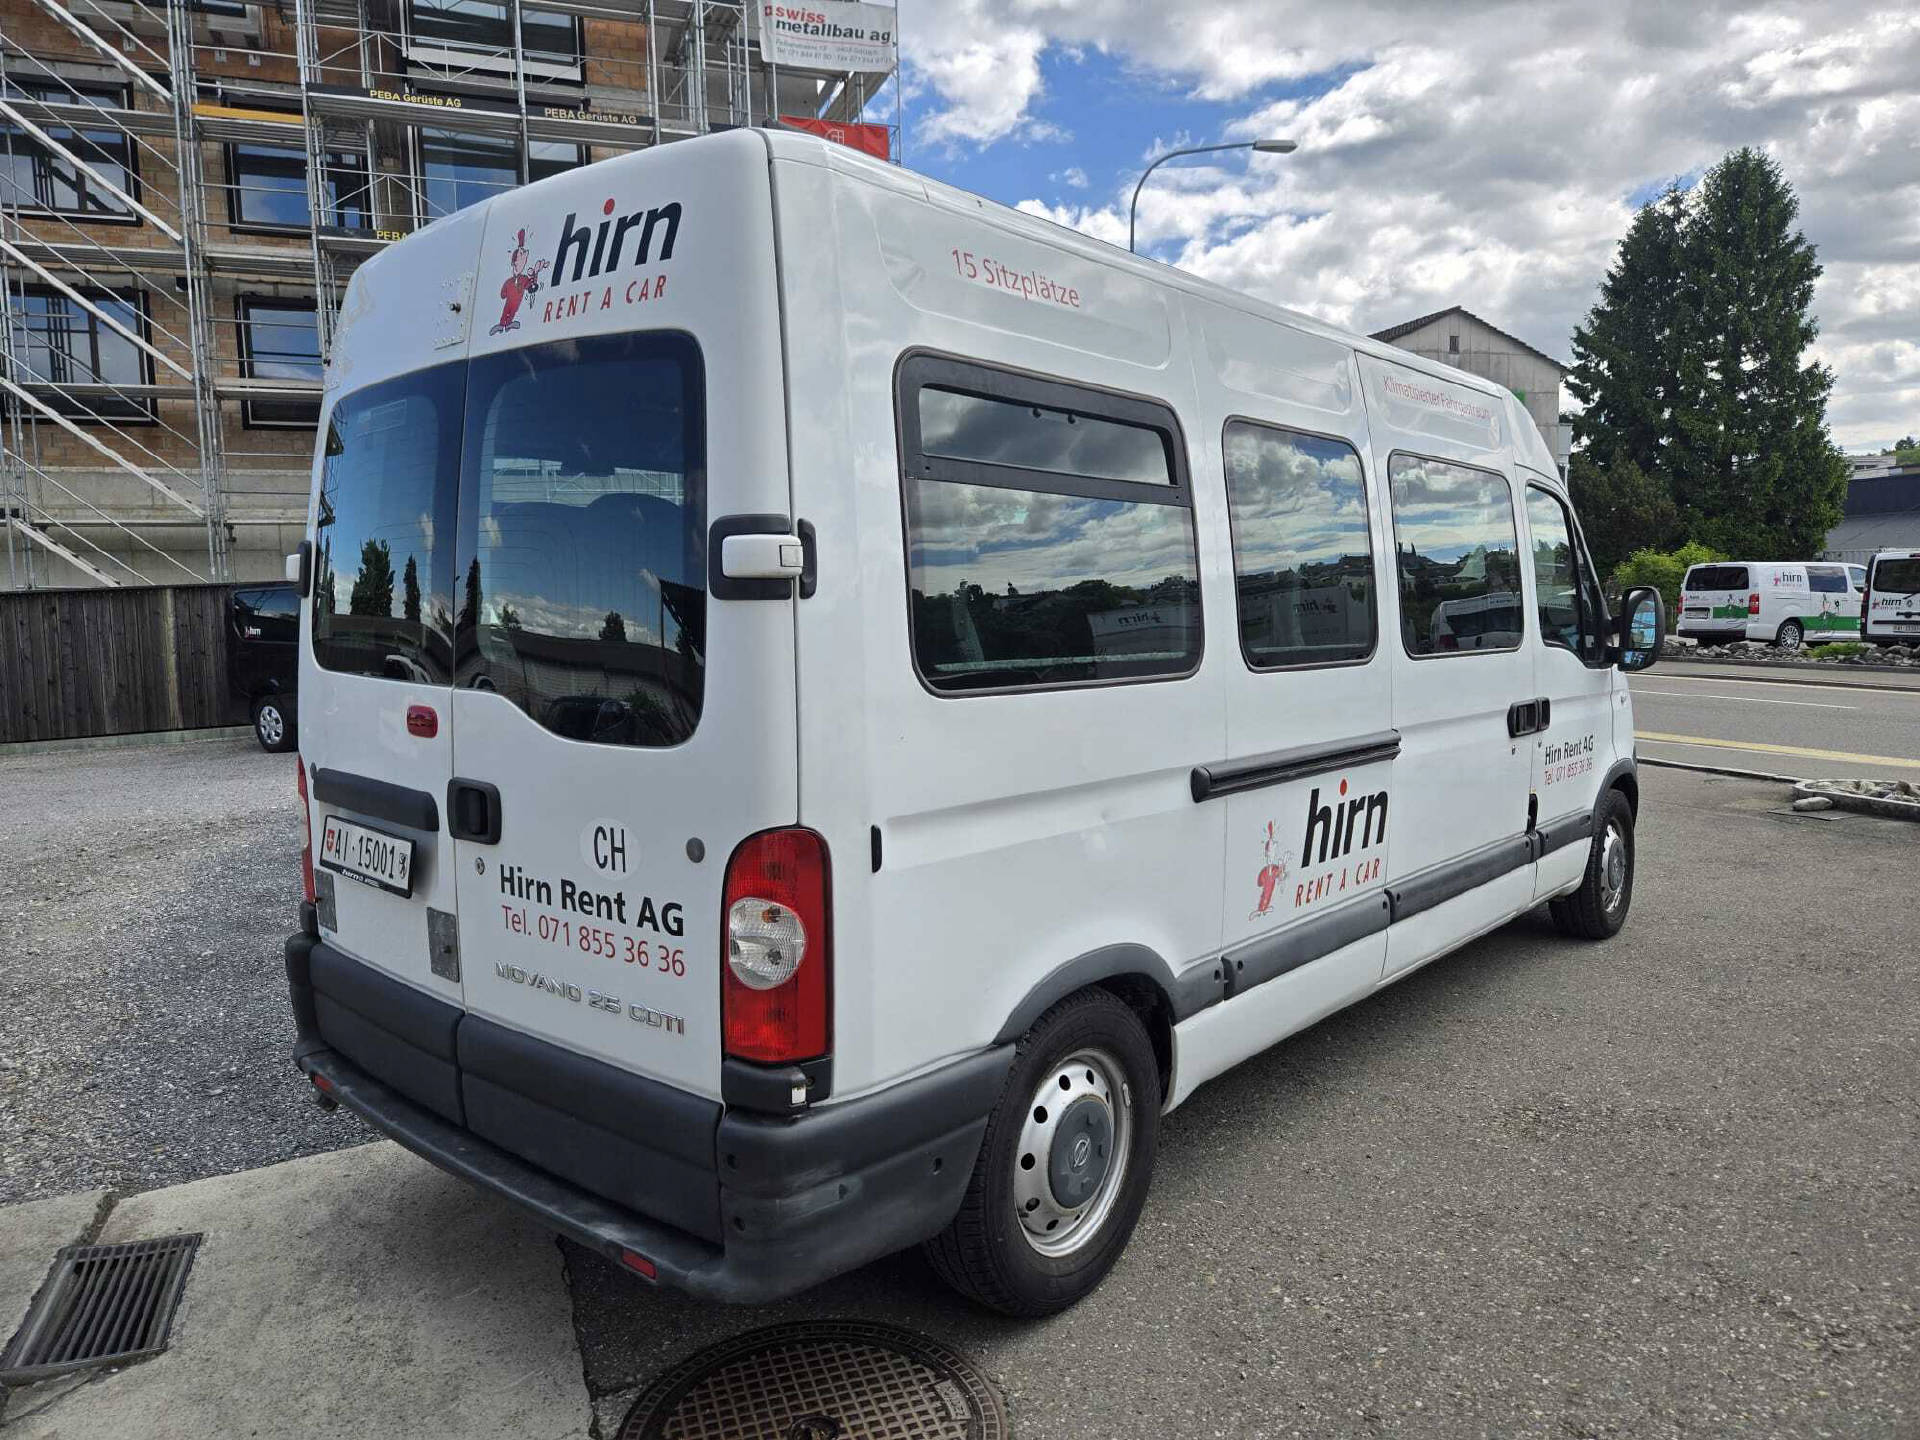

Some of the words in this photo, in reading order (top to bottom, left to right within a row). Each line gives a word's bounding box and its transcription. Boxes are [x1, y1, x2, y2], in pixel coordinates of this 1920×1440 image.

[776, 8, 826, 23] swiss
[776, 20, 864, 39] metallbau
[870, 30, 890, 44] ag
[370, 90, 400, 101] PEBA
[403, 93, 443, 106] Gerüste
[446, 97, 461, 108] AG
[544, 107, 575, 120] PEBA
[621, 113, 637, 125] AG
[376, 230, 408, 241] PEBA
[551, 198, 682, 287] hirn
[543, 291, 592, 323] RENT
[600, 286, 611, 310] A
[626, 275, 666, 304] CAR
[952, 249, 977, 279] 15
[983, 258, 1080, 308] Sitzplätze
[1782, 571, 1802, 583] hirn
[1881, 597, 1901, 606] hirn
[1545, 744, 1561, 766] Hirn
[1563, 740, 1582, 759] Rent
[1583, 735, 1594, 752] AG
[1301, 778, 1388, 869] hirn
[593, 825, 626, 873] CH
[500, 864, 552, 906] Hirn
[560, 878, 627, 925] Rent
[637, 896, 684, 937] AG
[1296, 873, 1333, 908] RENT
[1339, 868, 1347, 891] A
[1356, 858, 1380, 885] CAR
[502, 905, 532, 936] Tel.
[539, 915, 570, 947] 071
[579, 926, 616, 959] 855
[623, 936, 649, 967] 36
[658, 945, 685, 977] 36
[496, 960, 581, 1002] MOVANO
